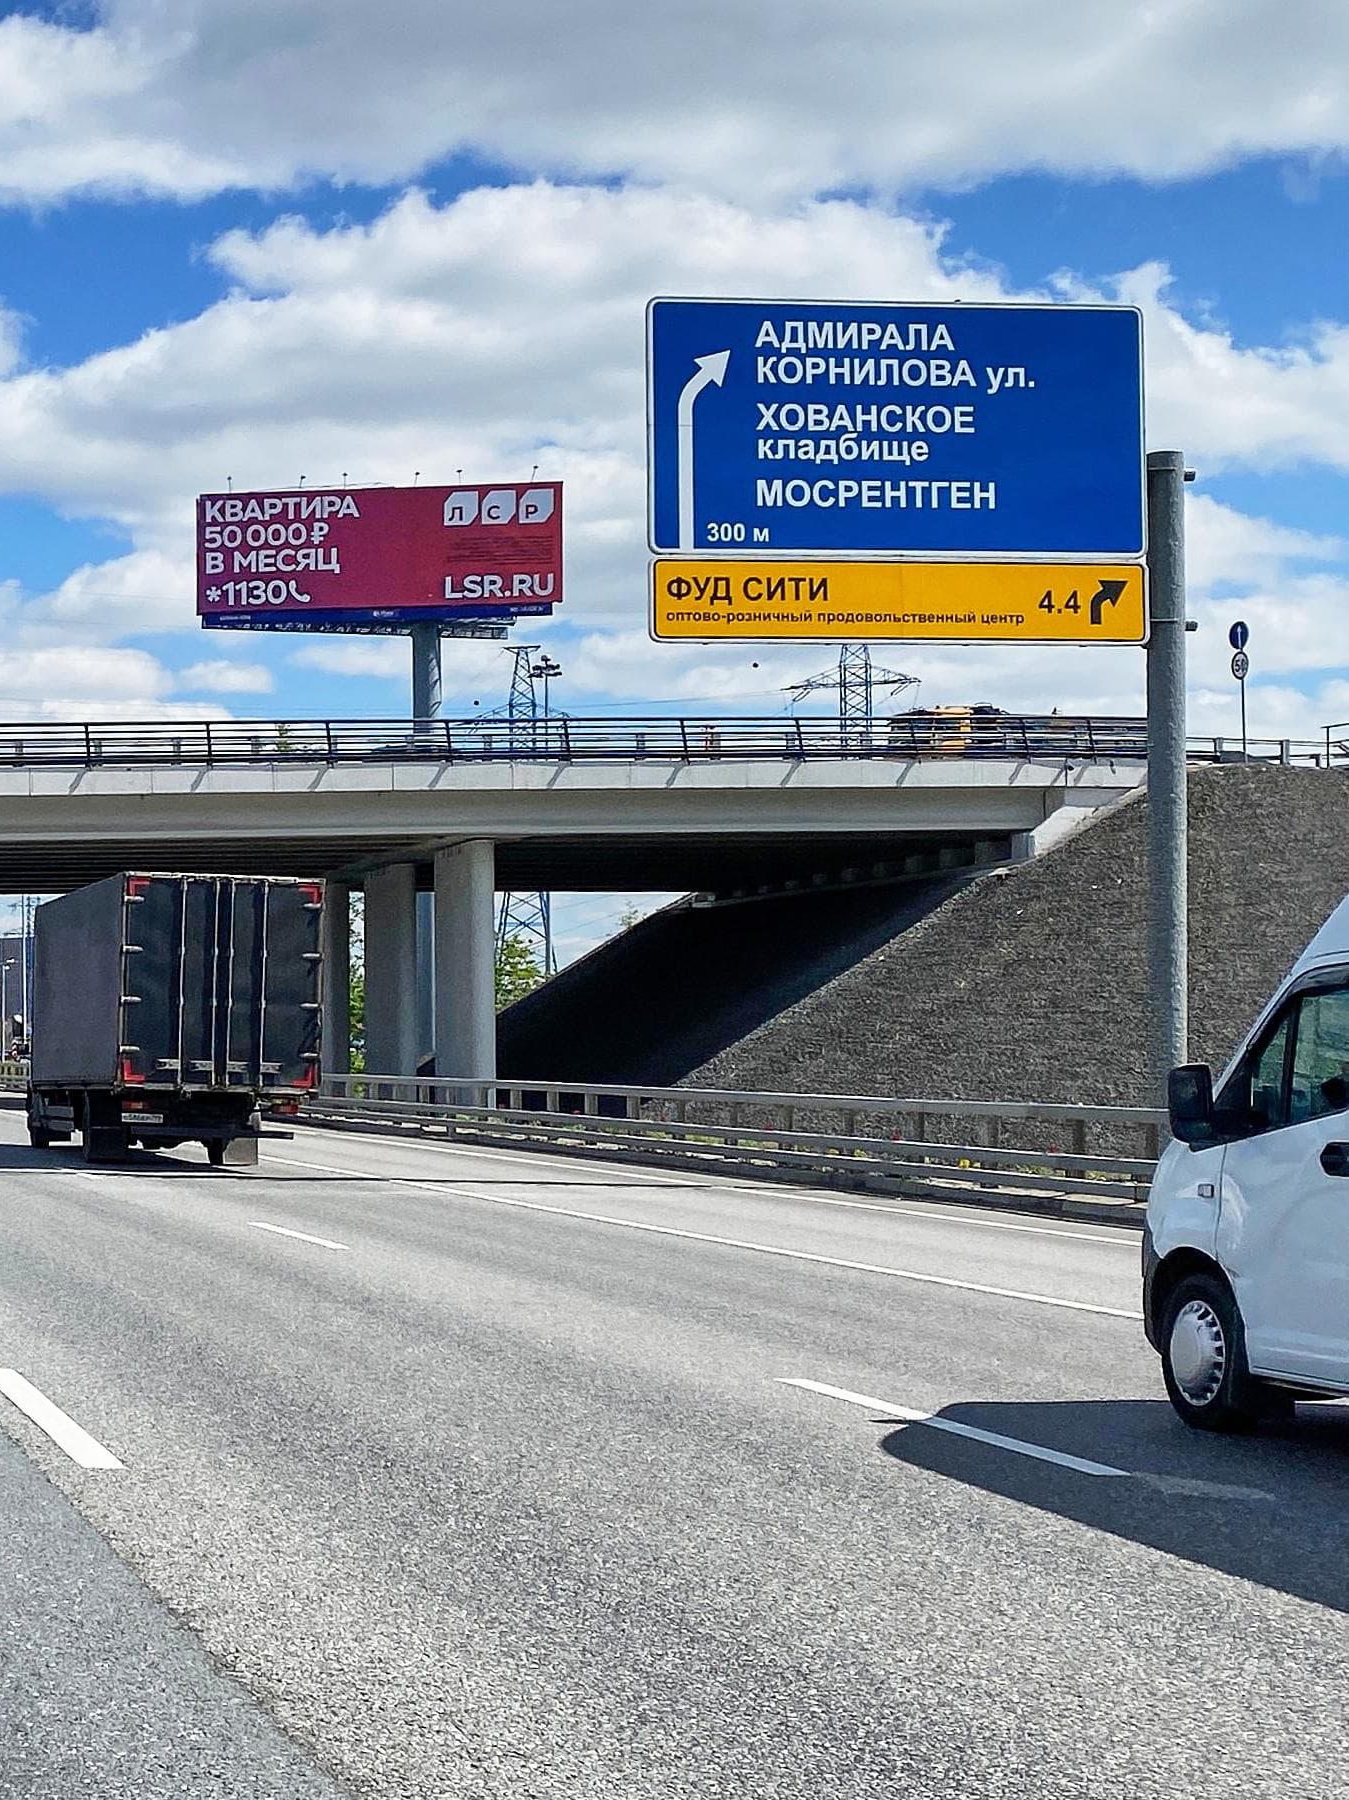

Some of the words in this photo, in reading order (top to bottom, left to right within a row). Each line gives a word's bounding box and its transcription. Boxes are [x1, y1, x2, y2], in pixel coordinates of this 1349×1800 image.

[755, 320, 955, 353] АДМИРАЛА
[756, 356, 976, 388] КОРНИЛОВА
[986, 367, 1036, 395] ул.
[756, 403, 975, 433] ХОВАНСКОЕ
[757, 432, 929, 466] кладбище
[756, 479, 995, 510] МОСРЕНТГЕН
[205, 496, 360, 523] КВАРТИРА
[706, 523, 746, 543] 300
[753, 528, 769, 543] м
[205, 551, 224, 574] В
[234, 548, 340, 574] МЕСЯЦ
[445, 573, 555, 599] LSR.RU
[666, 577, 733, 605] ФУД
[742, 577, 829, 601] СИТИ
[1038, 590, 1081, 614] 4.4
[666, 611, 813, 624] оптово-розничный
[817, 611, 976, 625] продовольственный
[981, 614, 1025, 625] центр
